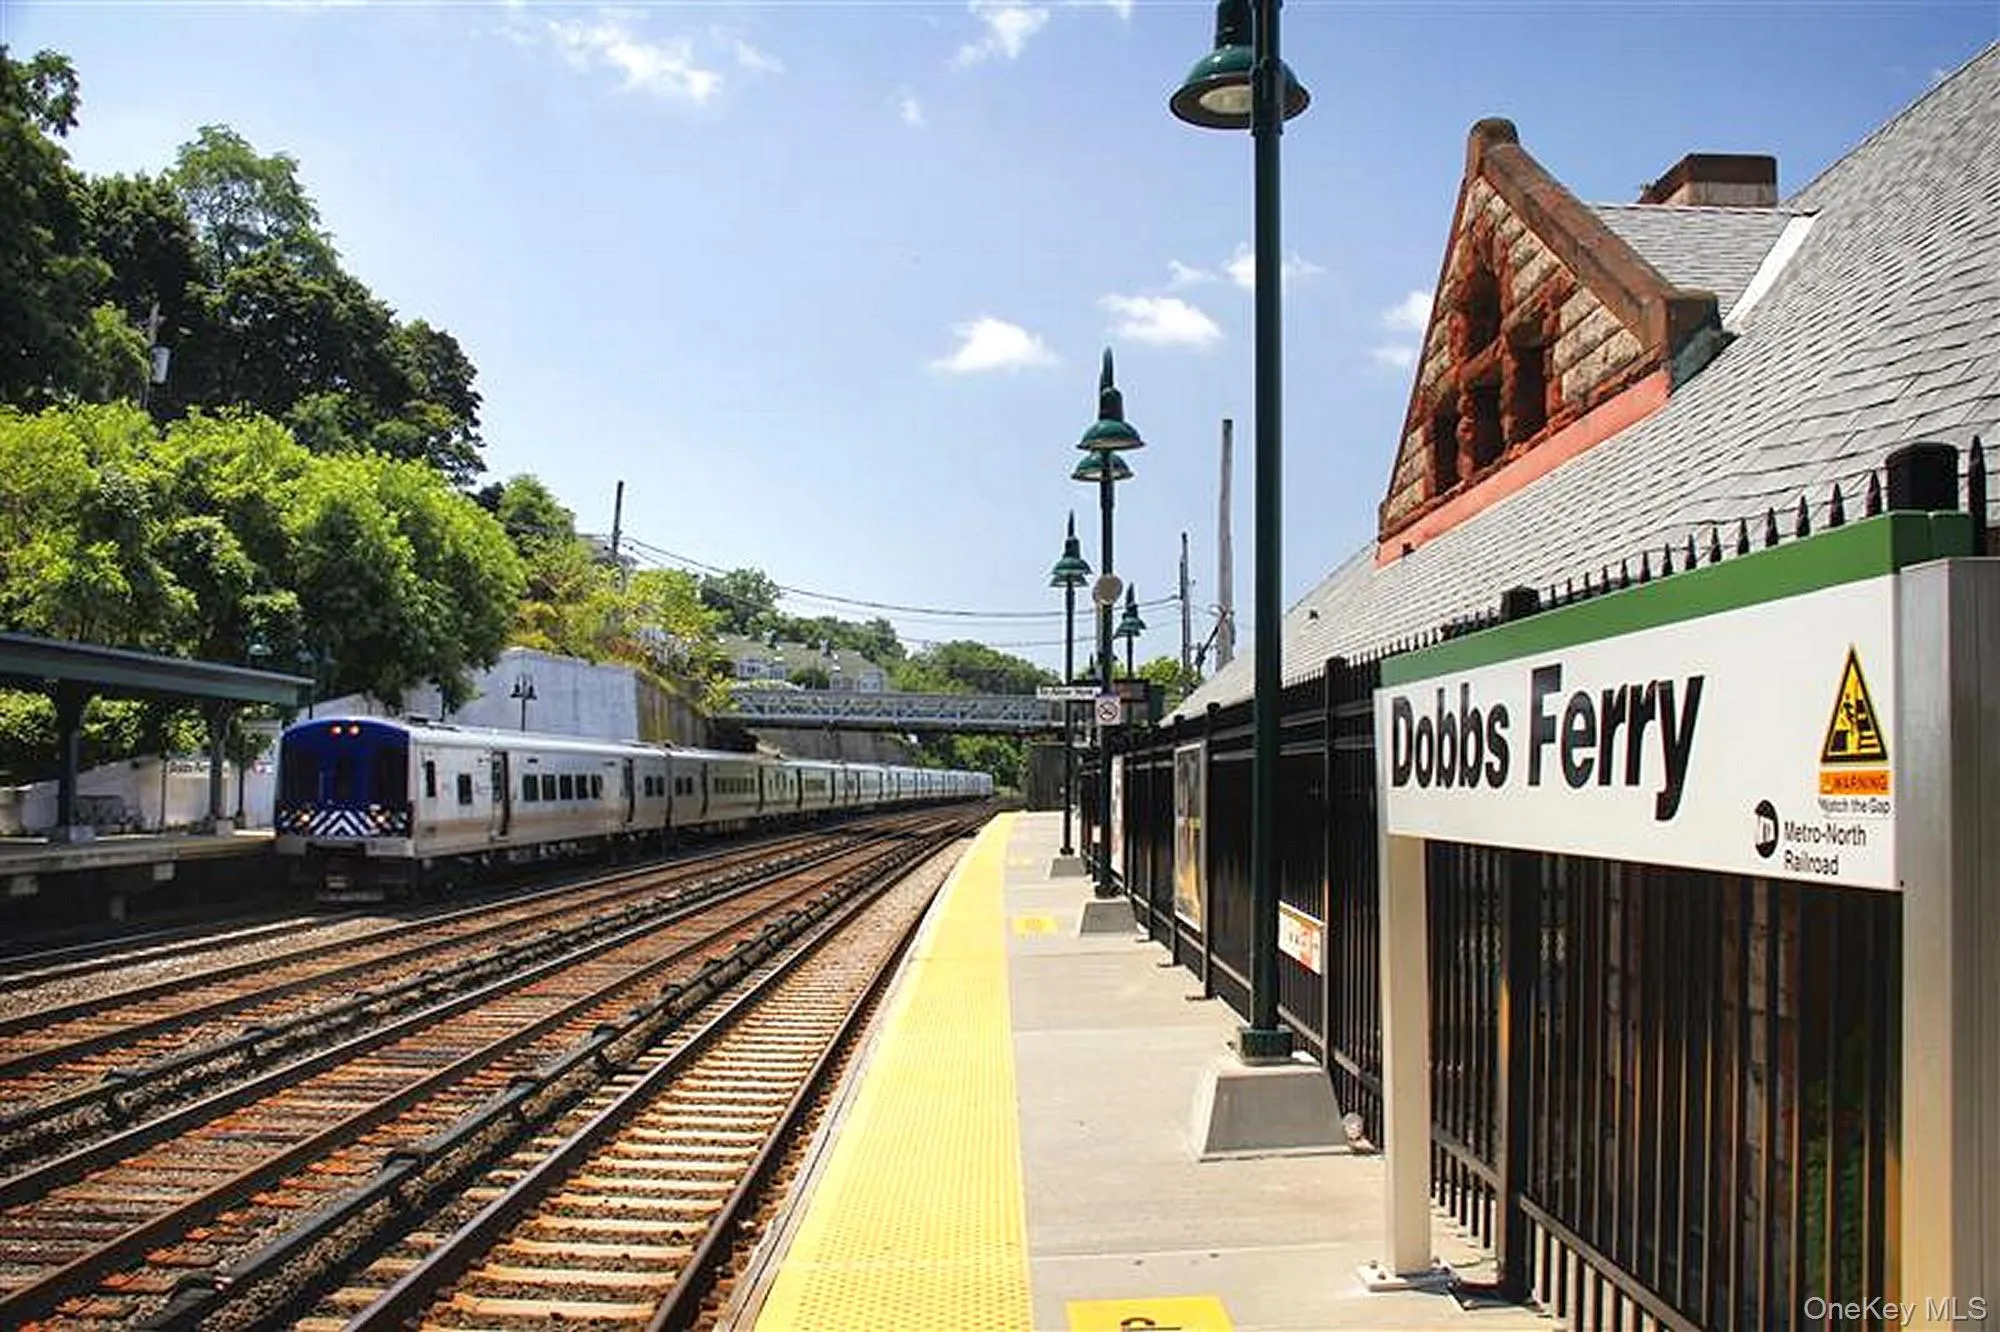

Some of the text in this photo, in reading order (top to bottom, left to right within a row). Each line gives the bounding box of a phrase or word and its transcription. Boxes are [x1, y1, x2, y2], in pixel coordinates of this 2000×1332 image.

[1391, 662, 1706, 822] Dobbs Ferry
[1850, 798, 1867, 814] the
[1868, 797, 1892, 815] Gap
[1783, 820, 1868, 847] Metro-North
[1783, 849, 1840, 877] Railroad
